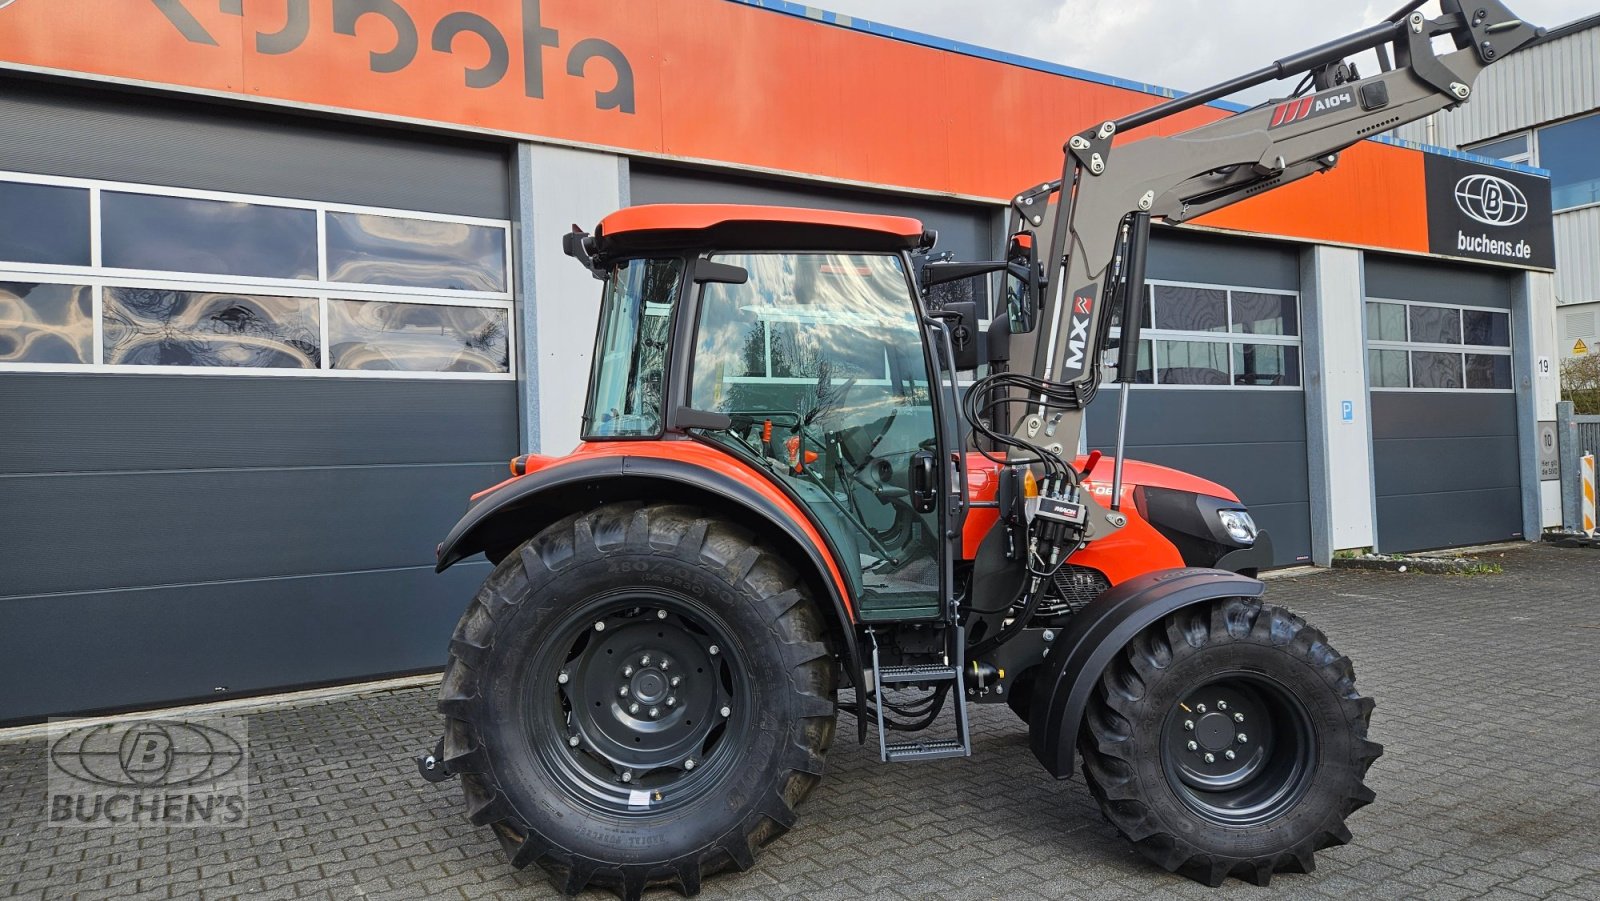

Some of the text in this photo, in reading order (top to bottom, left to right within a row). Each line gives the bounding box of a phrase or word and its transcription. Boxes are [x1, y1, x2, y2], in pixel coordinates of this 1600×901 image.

[1315, 92, 1351, 112] A104
[1457, 230, 1531, 259] buchens.de
[1065, 315, 1090, 370] MX
[1539, 359, 1549, 373] 19
